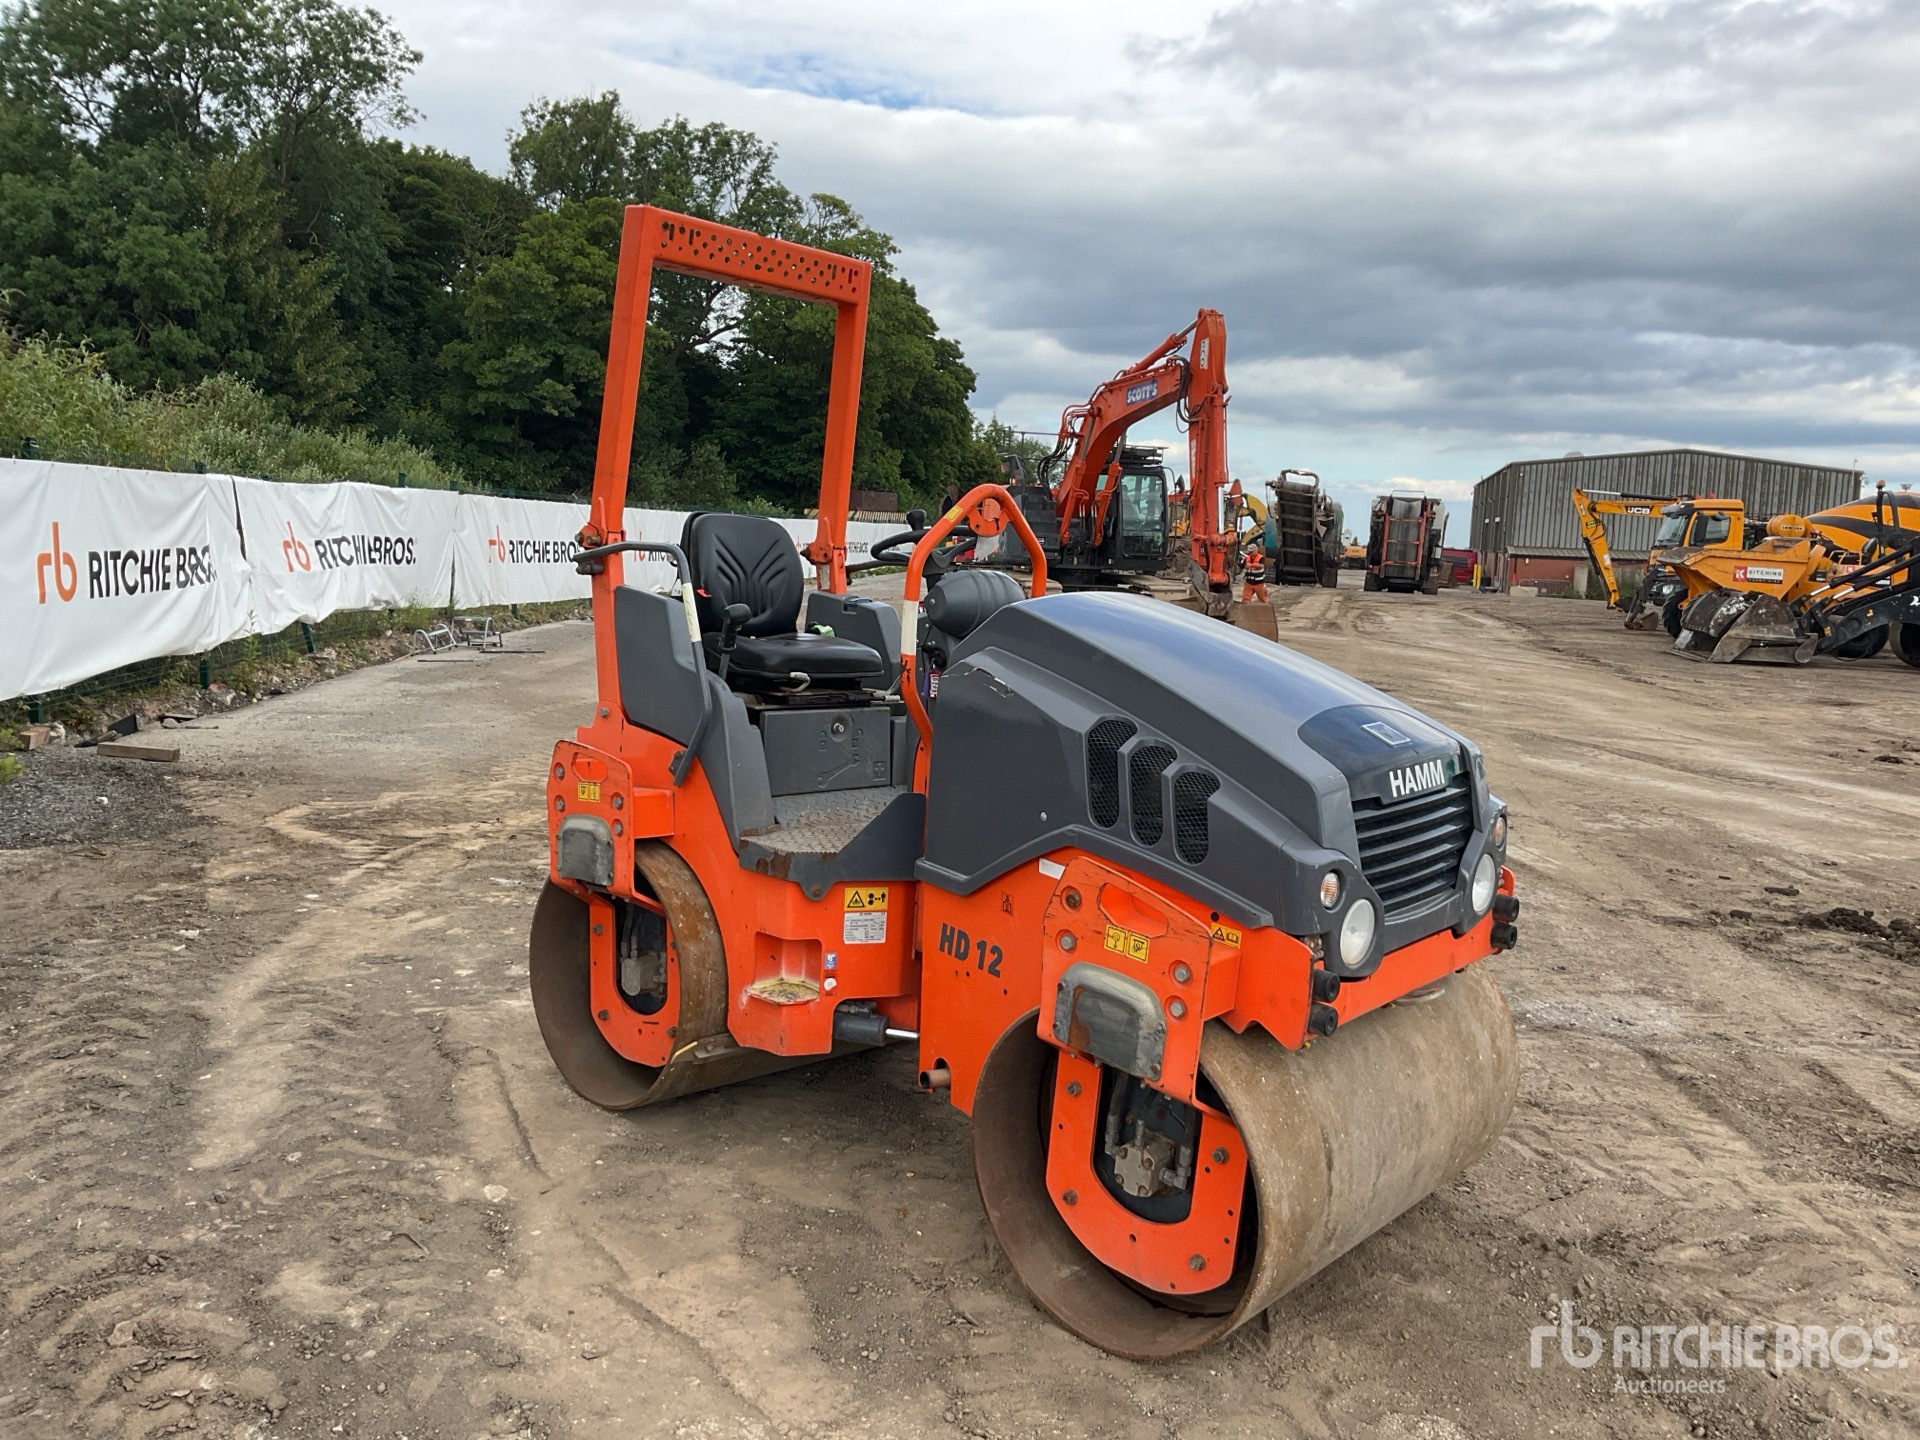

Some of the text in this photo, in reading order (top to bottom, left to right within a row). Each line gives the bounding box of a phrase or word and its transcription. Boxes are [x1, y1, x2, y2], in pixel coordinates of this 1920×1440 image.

[1127, 383, 1158, 404] SCOTT'S
[1627, 507, 1651, 515] JCB
[314, 535, 377, 570] RITCHIE
[509, 540, 551, 564] RITCHIE
[87, 548, 171, 599] RITCHIE
[1748, 569, 1782, 577] KITCHING
[1388, 759, 1446, 798] HAMM
[939, 922, 1004, 979] HD 12
